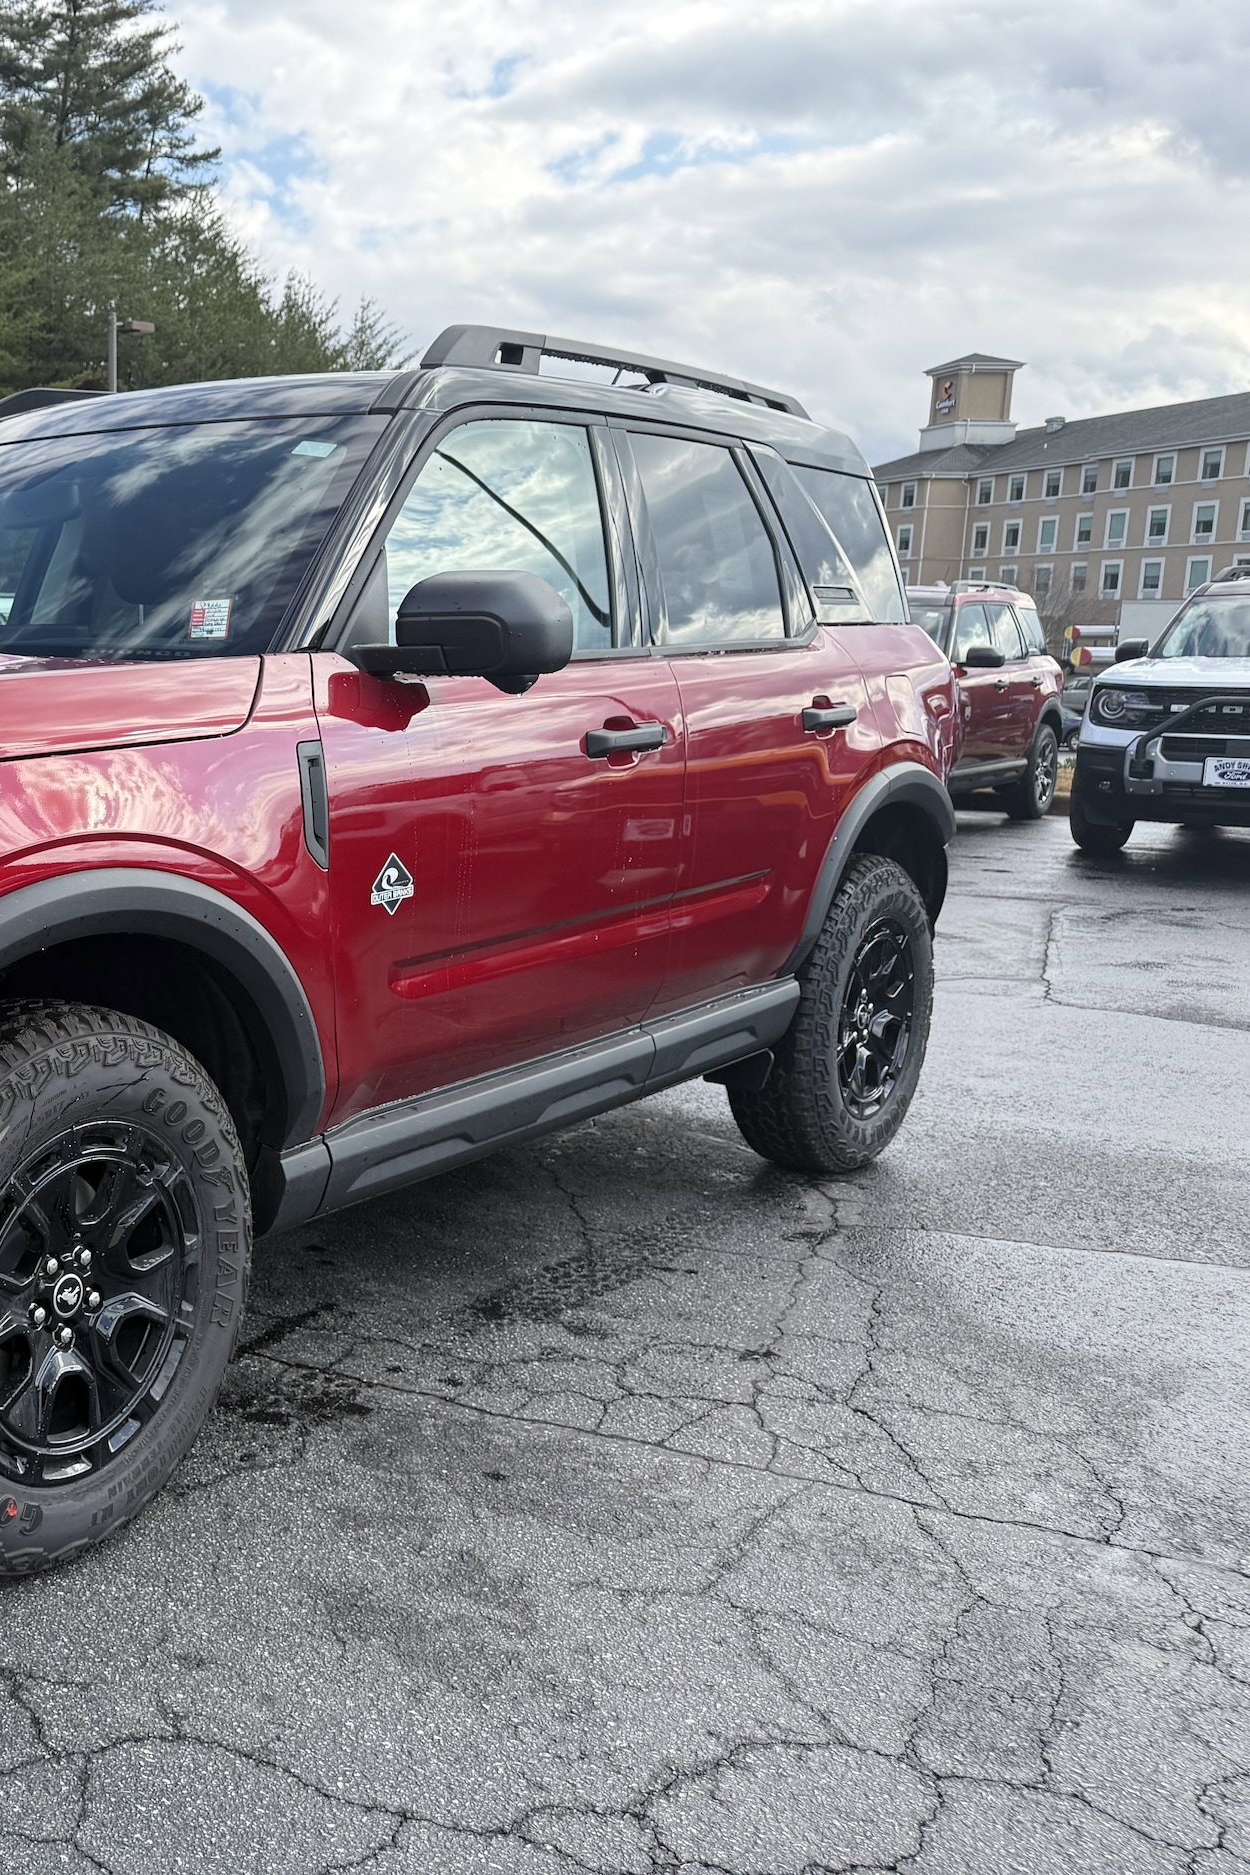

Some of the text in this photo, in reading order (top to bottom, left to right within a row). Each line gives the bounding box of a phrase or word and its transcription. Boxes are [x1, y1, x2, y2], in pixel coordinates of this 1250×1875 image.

[1214, 761, 1250, 773] ANDY SH
[372, 890, 393, 904] OUTER
[143, 1086, 240, 1328] GOODYEAR
